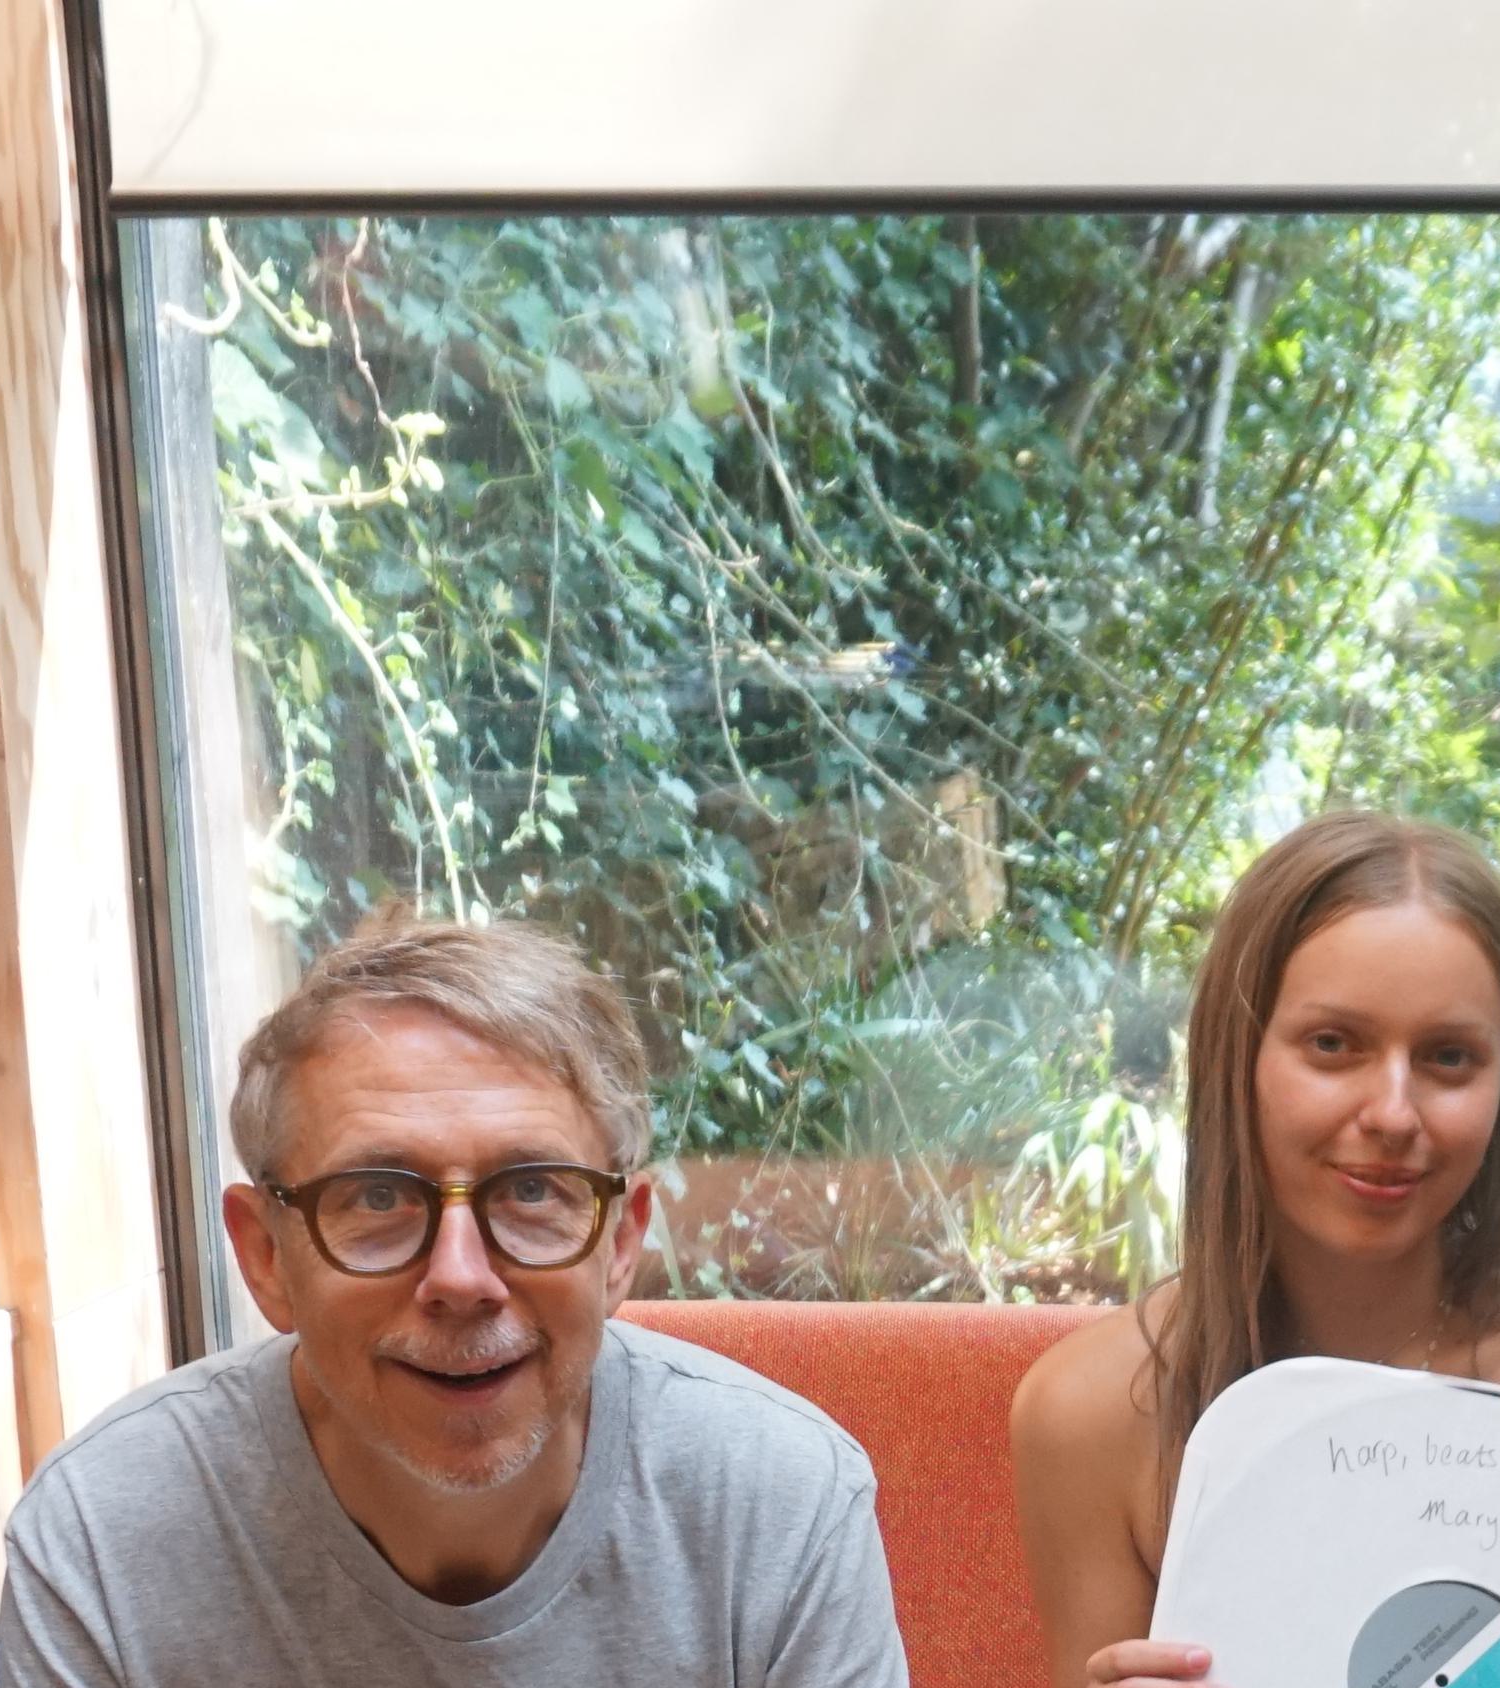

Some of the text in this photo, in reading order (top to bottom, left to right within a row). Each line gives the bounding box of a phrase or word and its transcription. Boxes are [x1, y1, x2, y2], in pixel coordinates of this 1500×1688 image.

[1328, 1437, 1408, 1476] harp,
[1426, 1433, 1498, 1469] beats
[1413, 1624, 1443, 1652] TEST
